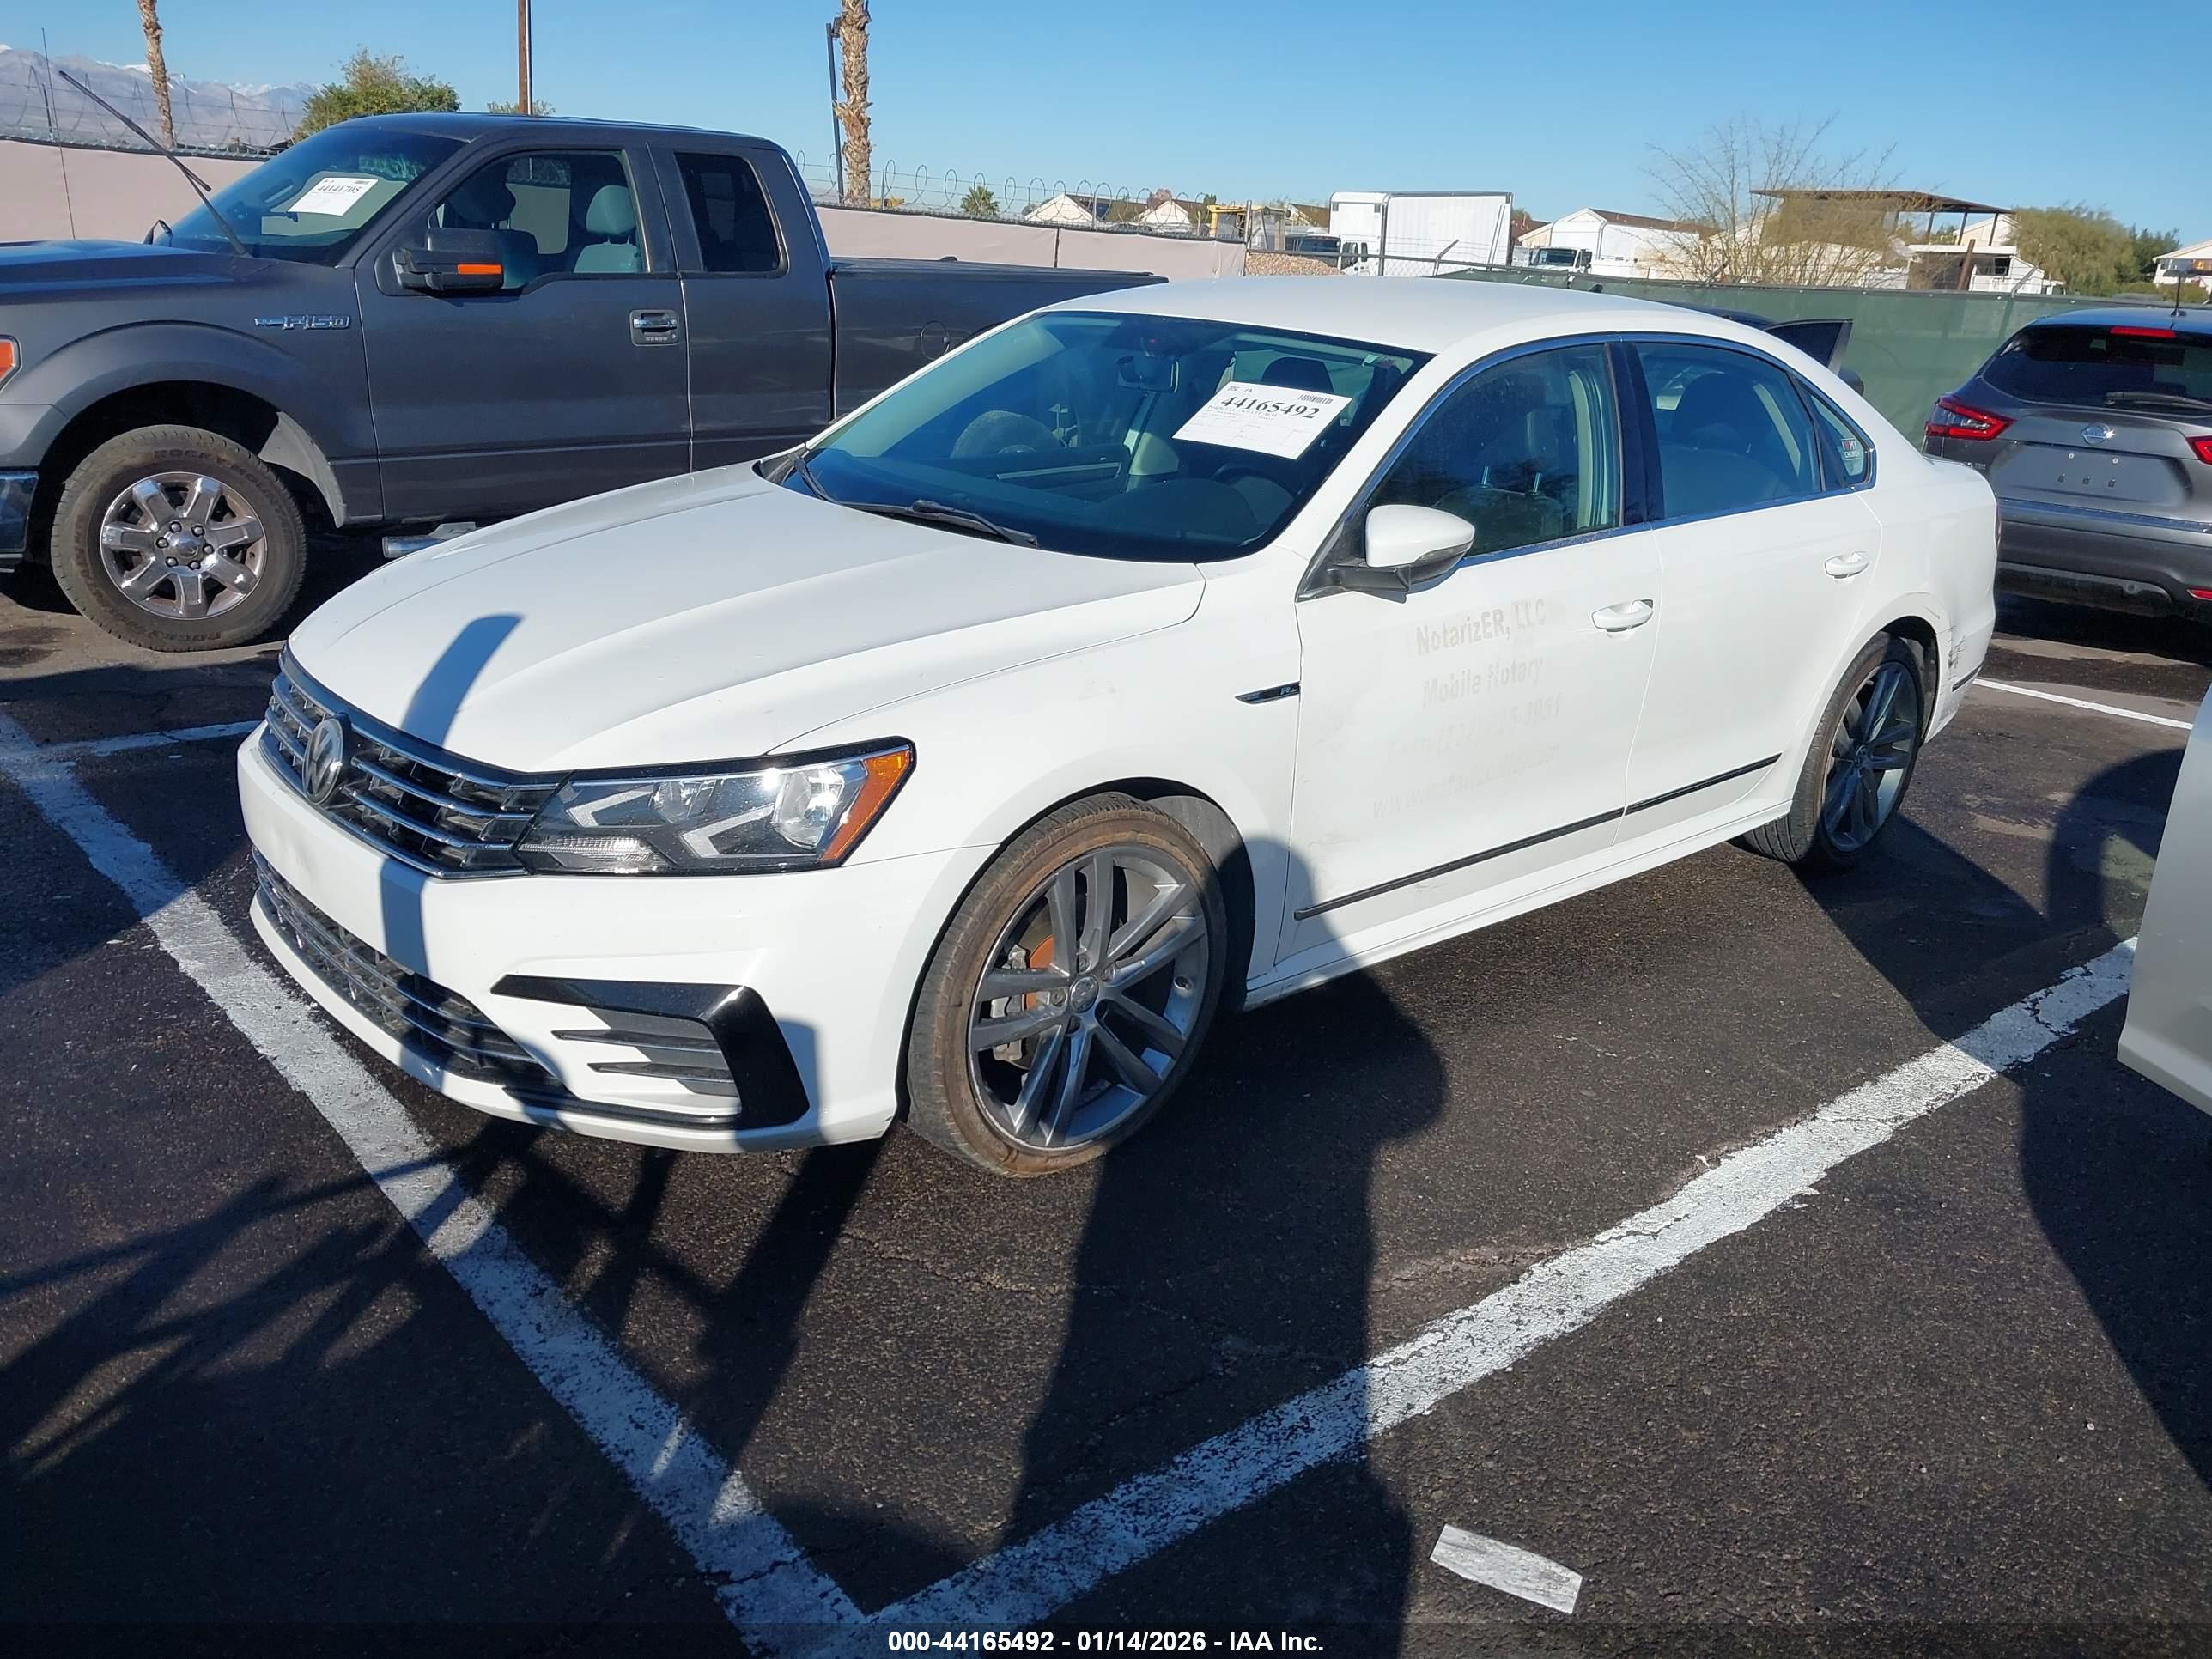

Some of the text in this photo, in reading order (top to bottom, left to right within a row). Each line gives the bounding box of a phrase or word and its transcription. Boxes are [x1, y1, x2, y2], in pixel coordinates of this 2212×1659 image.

[1220, 395, 1321, 420] 44165492
[1415, 607, 1510, 656] NotarizER,
[1421, 668, 1482, 708] Mobile
